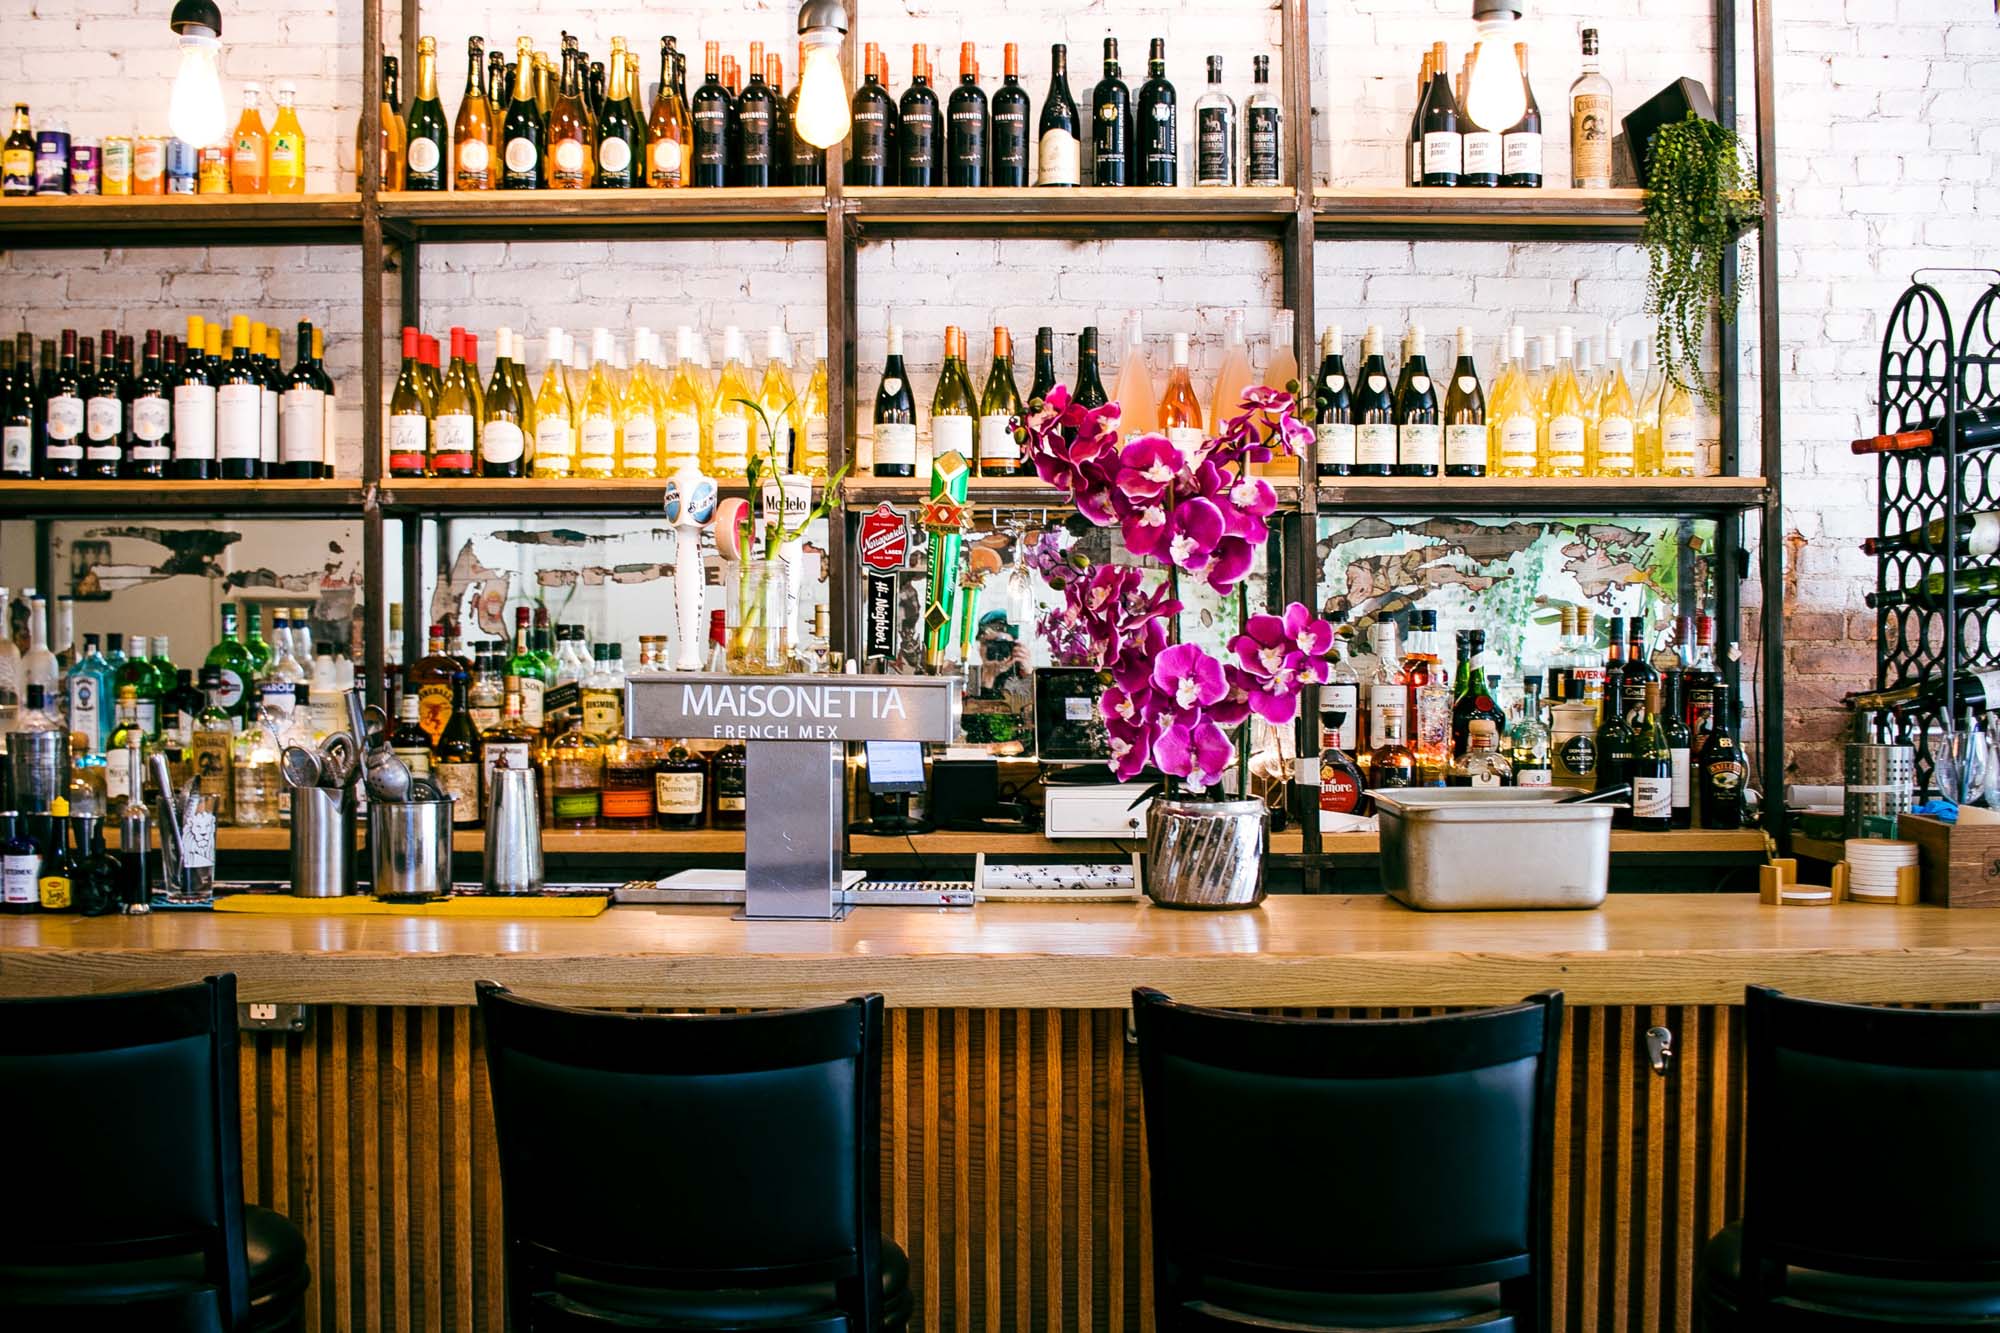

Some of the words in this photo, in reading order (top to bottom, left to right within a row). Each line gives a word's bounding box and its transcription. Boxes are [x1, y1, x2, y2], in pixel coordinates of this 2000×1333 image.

[1575, 670, 1606, 680] AVERN
[714, 725, 789, 739] FRENCH
[799, 725, 838, 739] MEX
